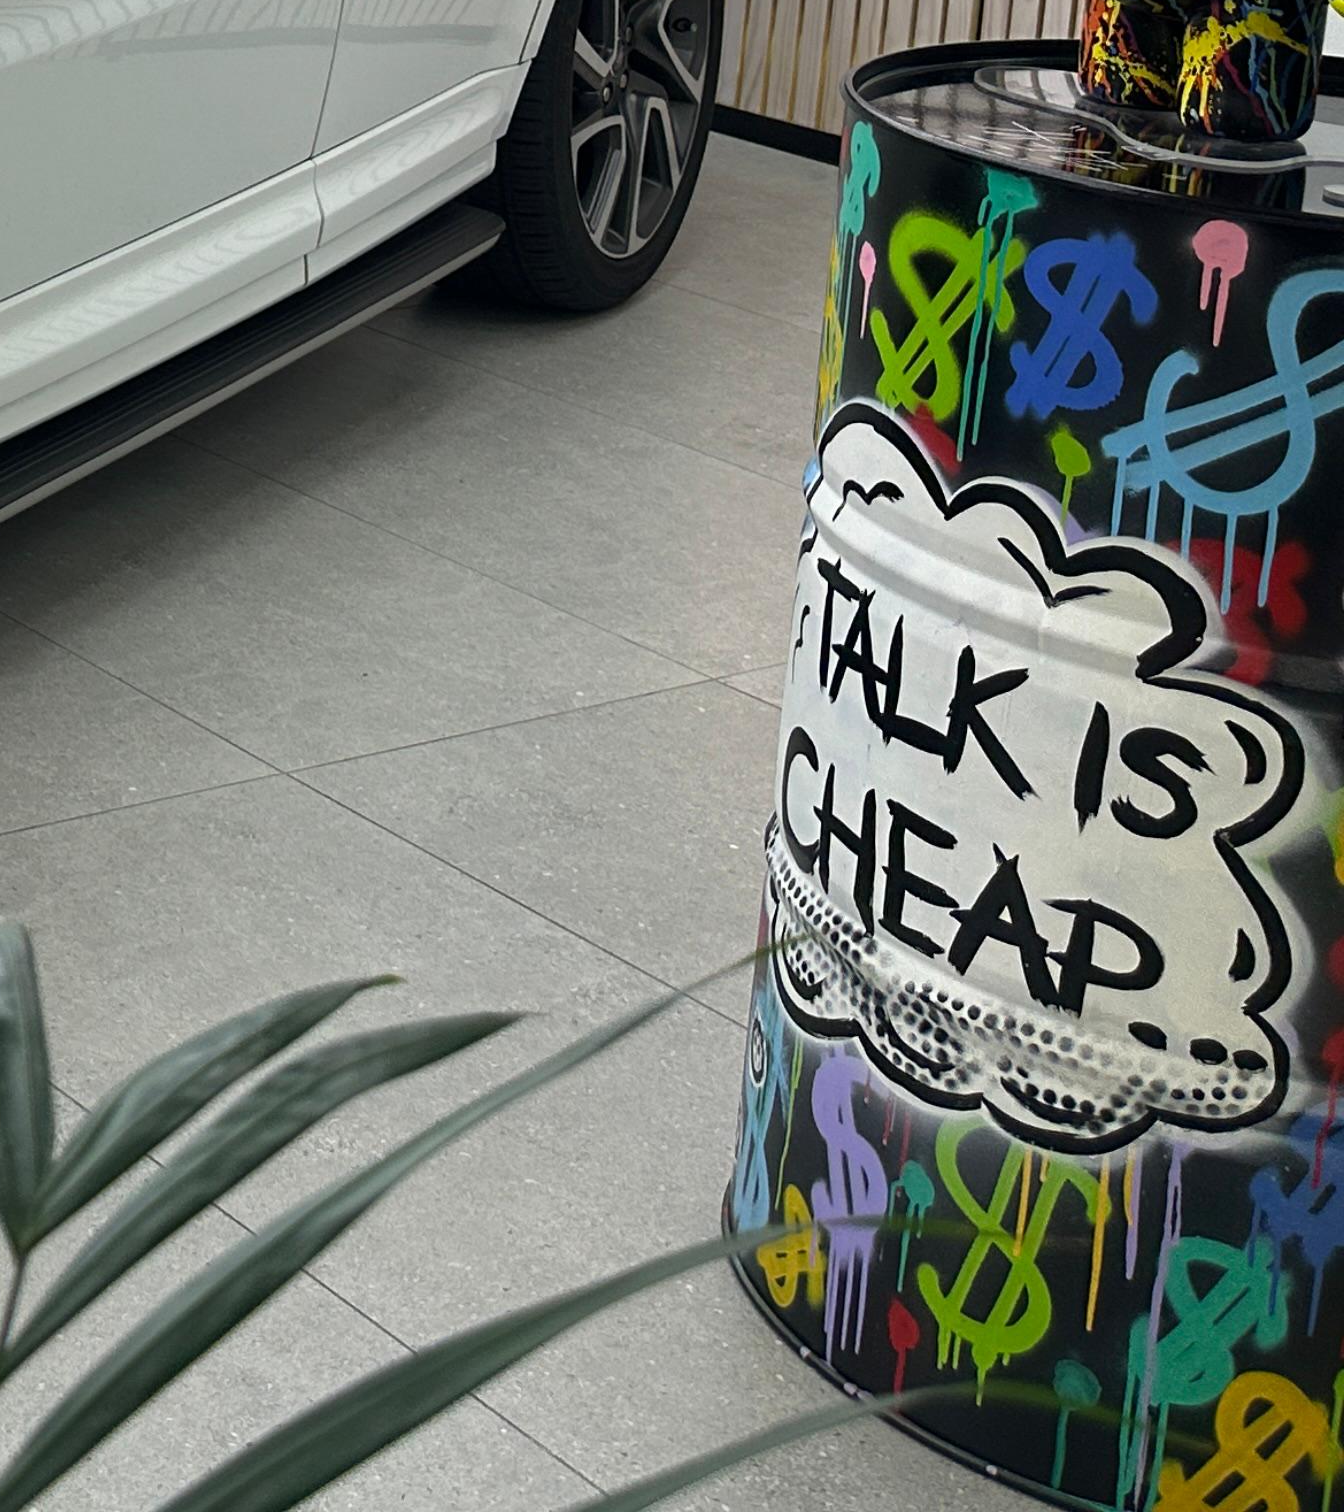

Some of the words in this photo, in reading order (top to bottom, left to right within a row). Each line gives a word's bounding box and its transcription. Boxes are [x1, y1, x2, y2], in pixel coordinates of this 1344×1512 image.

[817, 557, 1040, 800] TALK
[1074, 701, 1216, 840] IS
[781, 726, 1165, 1018] CHEAP
